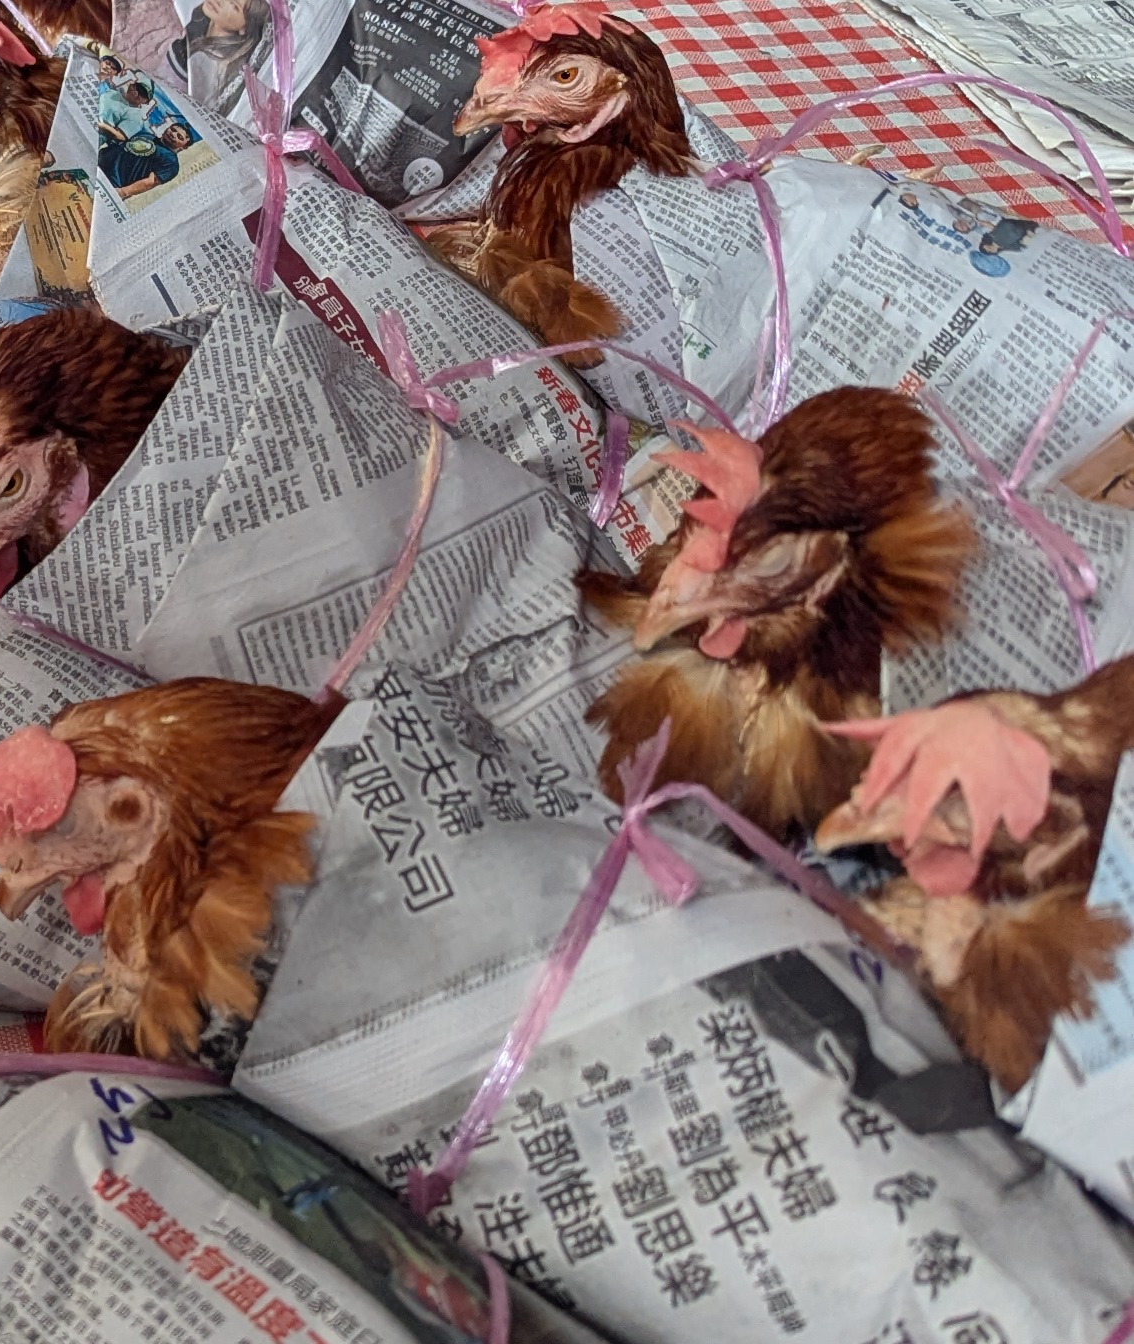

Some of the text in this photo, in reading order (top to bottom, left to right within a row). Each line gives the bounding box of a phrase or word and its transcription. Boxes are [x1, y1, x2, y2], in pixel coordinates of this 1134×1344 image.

[236, 296, 246, 310] an
[208, 344, 228, 394] instantly
[218, 324, 242, 405] six centuries of
[227, 313, 250, 396] walls and grey
[275, 364, 287, 377] to
[182, 394, 202, 460] from Jinan,
[204, 391, 221, 423] alleys
[213, 434, 226, 456] and
[274, 396, 302, 451] landscape.
[281, 343, 343, 497] Taken together, these cases
[283, 384, 305, 426] broader
[154, 454, 164, 465] to
[165, 439, 176, 452] in
[176, 431, 190, 460] After
[199, 419, 214, 458] said Li
[243, 452, 256, 466] of
[262, 396, 309, 511] Baidu's Robin Li and
[298, 425, 315, 450] shift
[307, 450, 318, 462] in
[180, 478, 192, 492] of
[250, 434, 273, 479] internet
[266, 485, 281, 507] era,
[262, 437, 283, 472] Zhang
[276, 478, 298, 515] helped
[311, 462, 332, 501] China's
[131, 485, 141, 511] level
[156, 481, 174, 556] development.
[168, 480, 187, 544] to balance
[231, 498, 242, 512] as
[233, 465, 248, 489] now
[241, 493, 262, 529] taking
[82, 518, 95, 560] sections
[117, 487, 136, 588] traditional villages.
[134, 520, 145, 540] and
[141, 483, 164, 579] currently boasts
[212, 521, 226, 541] and
[70, 540, 86, 604] conservation
[78, 605, 88, 621] has
[86, 563, 96, 573] in
[93, 506, 118, 650] the foot of the ancient Great
[106, 499, 131, 652] In Shizikou Village, located
